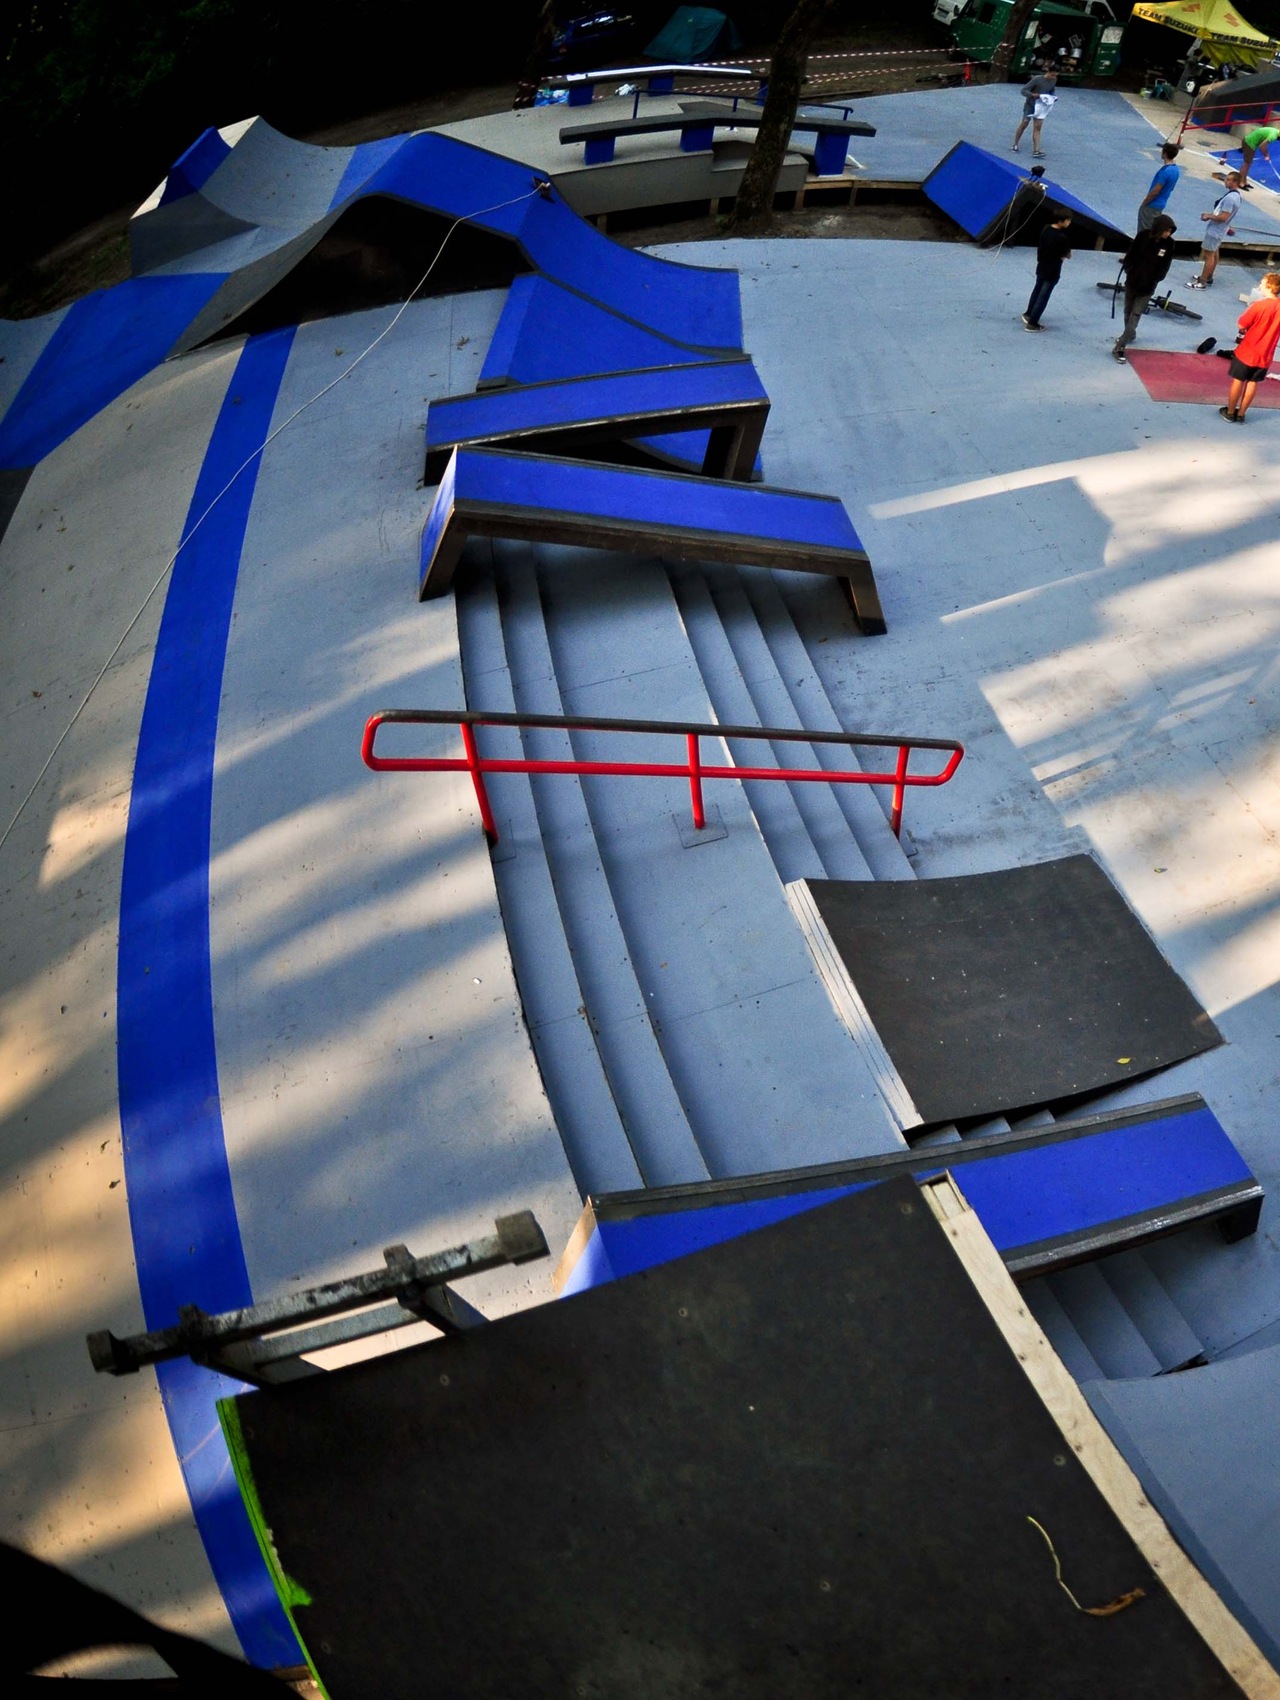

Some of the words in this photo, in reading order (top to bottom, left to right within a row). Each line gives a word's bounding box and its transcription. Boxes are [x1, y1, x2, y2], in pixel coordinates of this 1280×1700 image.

[1138, 8, 1163, 22] TEAM
[1164, 16, 1199, 34] SUZUKI
[1211, 33, 1239, 43] TEAM
